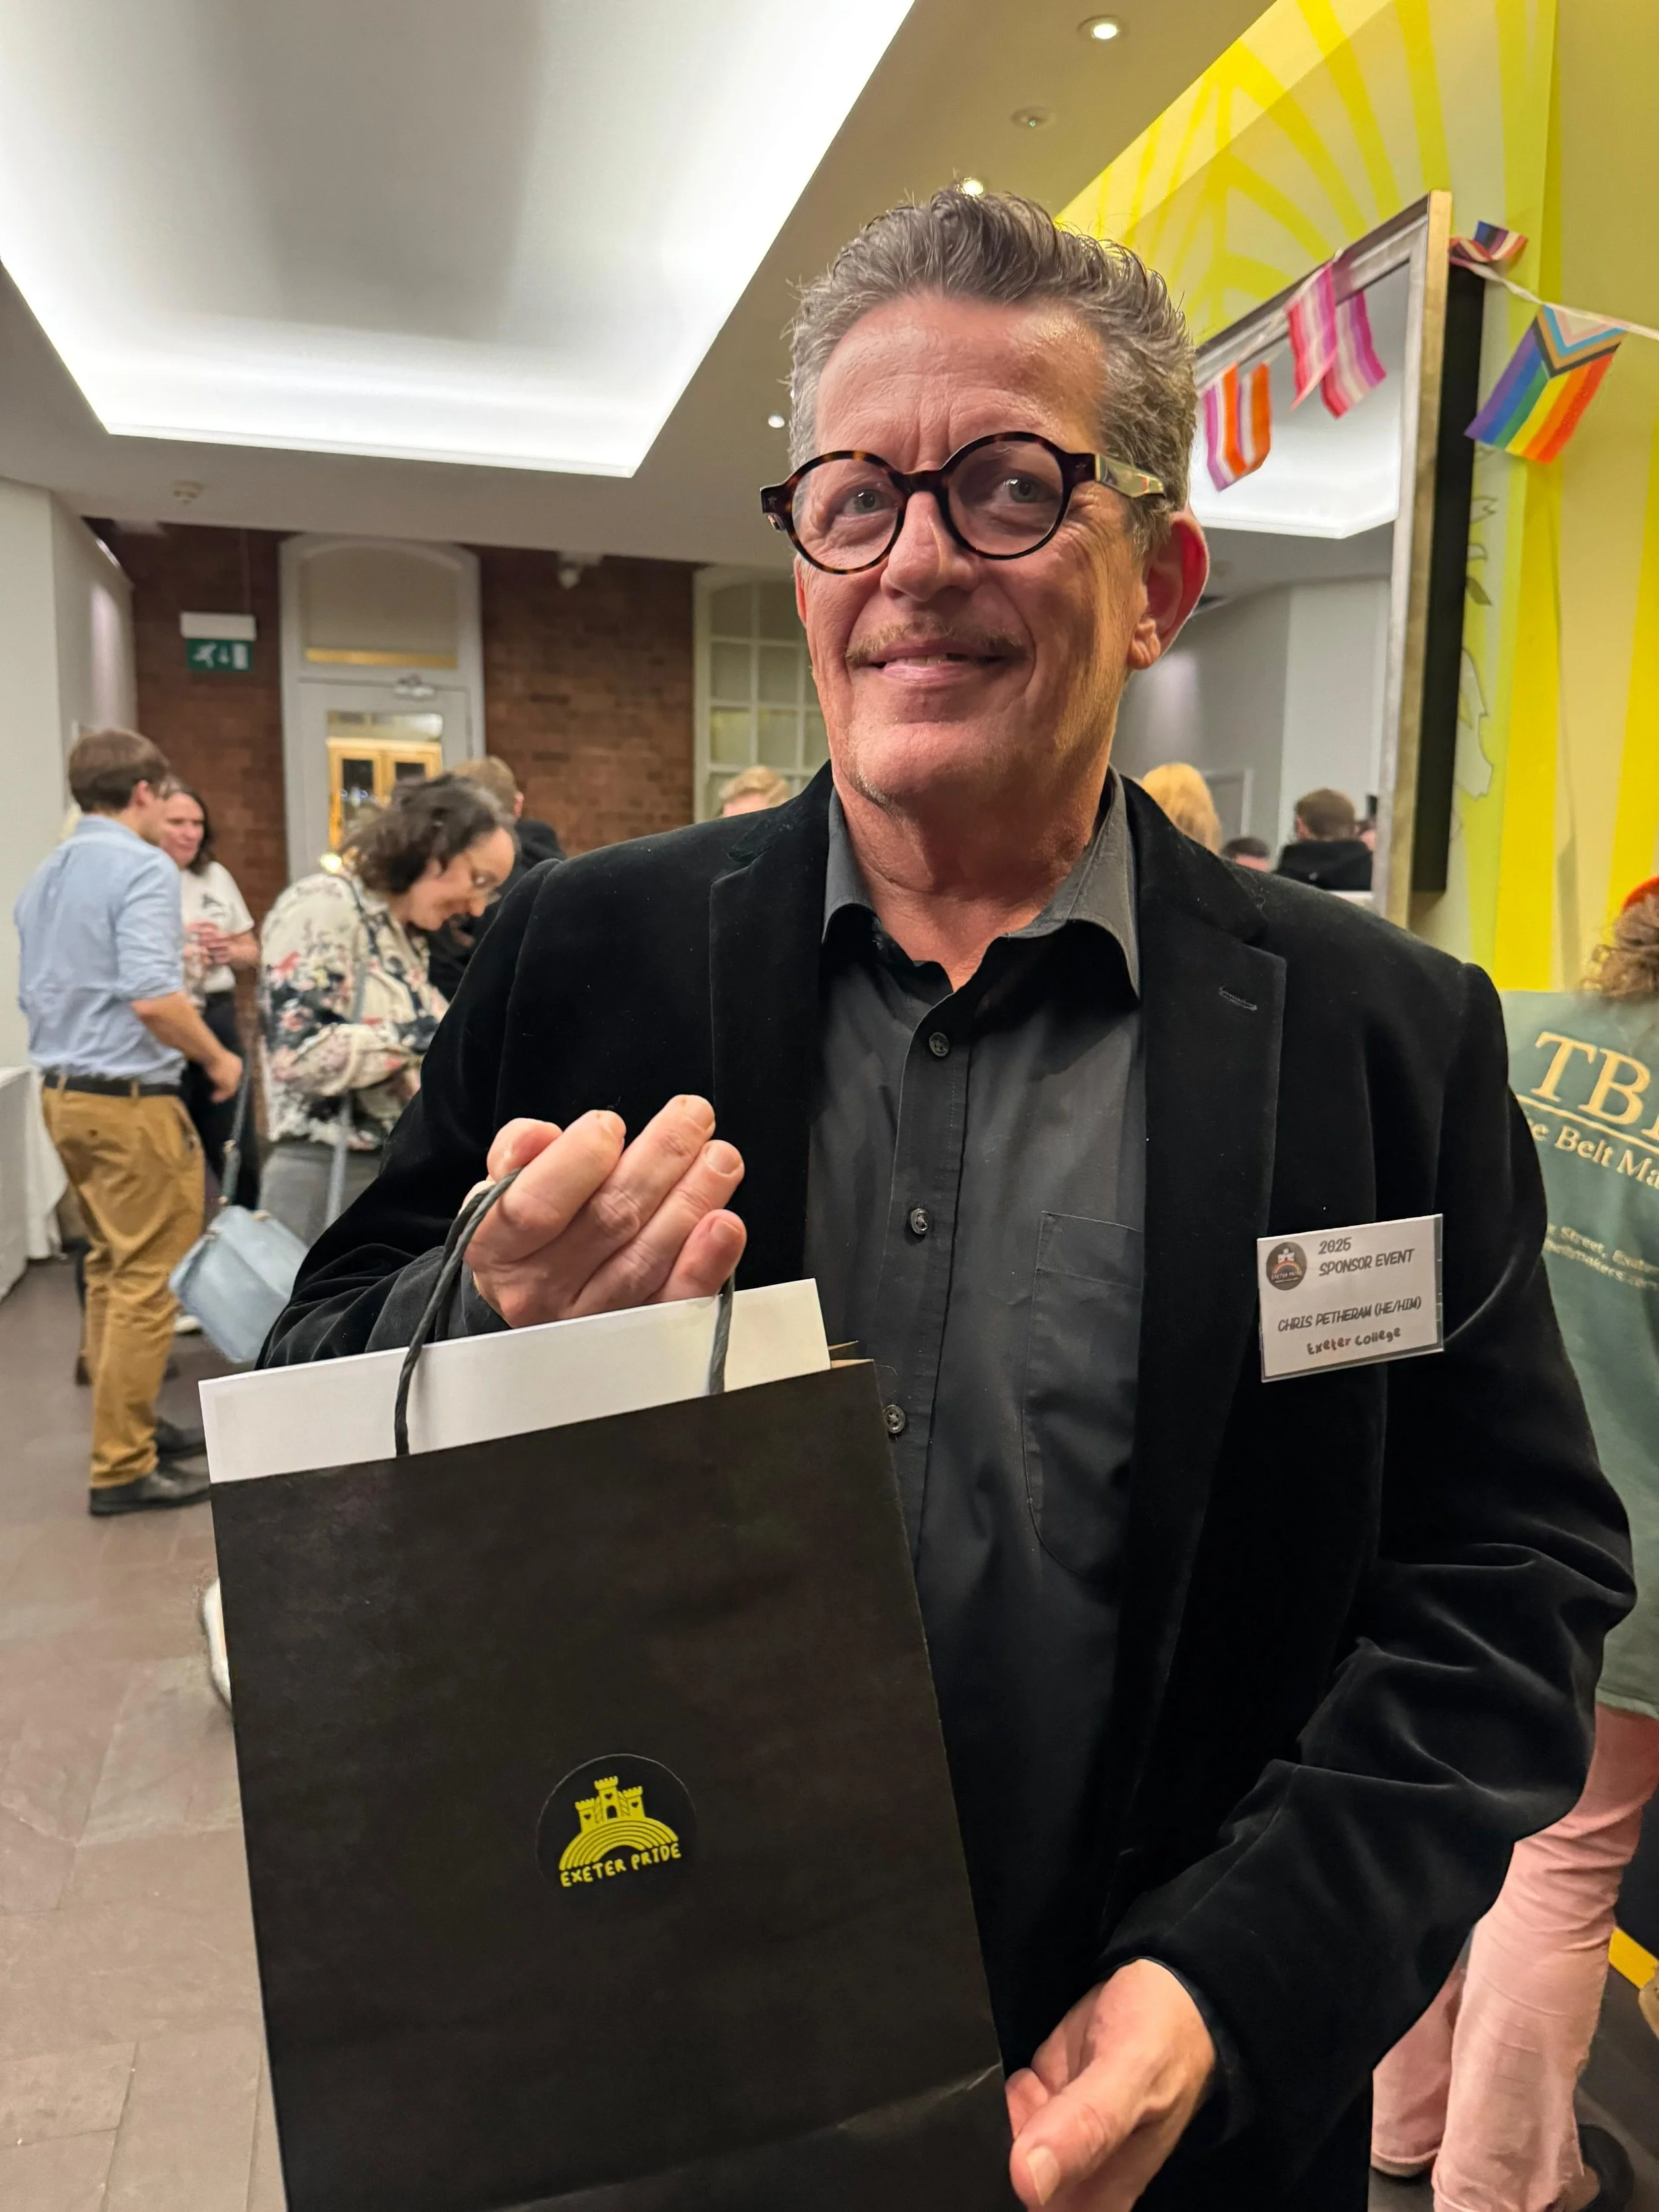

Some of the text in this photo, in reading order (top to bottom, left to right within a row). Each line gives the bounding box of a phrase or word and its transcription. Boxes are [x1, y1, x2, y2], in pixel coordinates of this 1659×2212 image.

[1530, 1031, 1659, 1141] TB
[1554, 1125, 1614, 1168] Belt
[1318, 1236, 1352, 1255] 2025
[1319, 1248, 1415, 1277] SPONSOR EVENT
[1278, 1295, 1421, 1332] CHRIS PETHERAM (HE/HIM)
[1307, 1327, 1401, 1355] Exeter College
[560, 1842, 682, 1887] EXETER PRIDE
